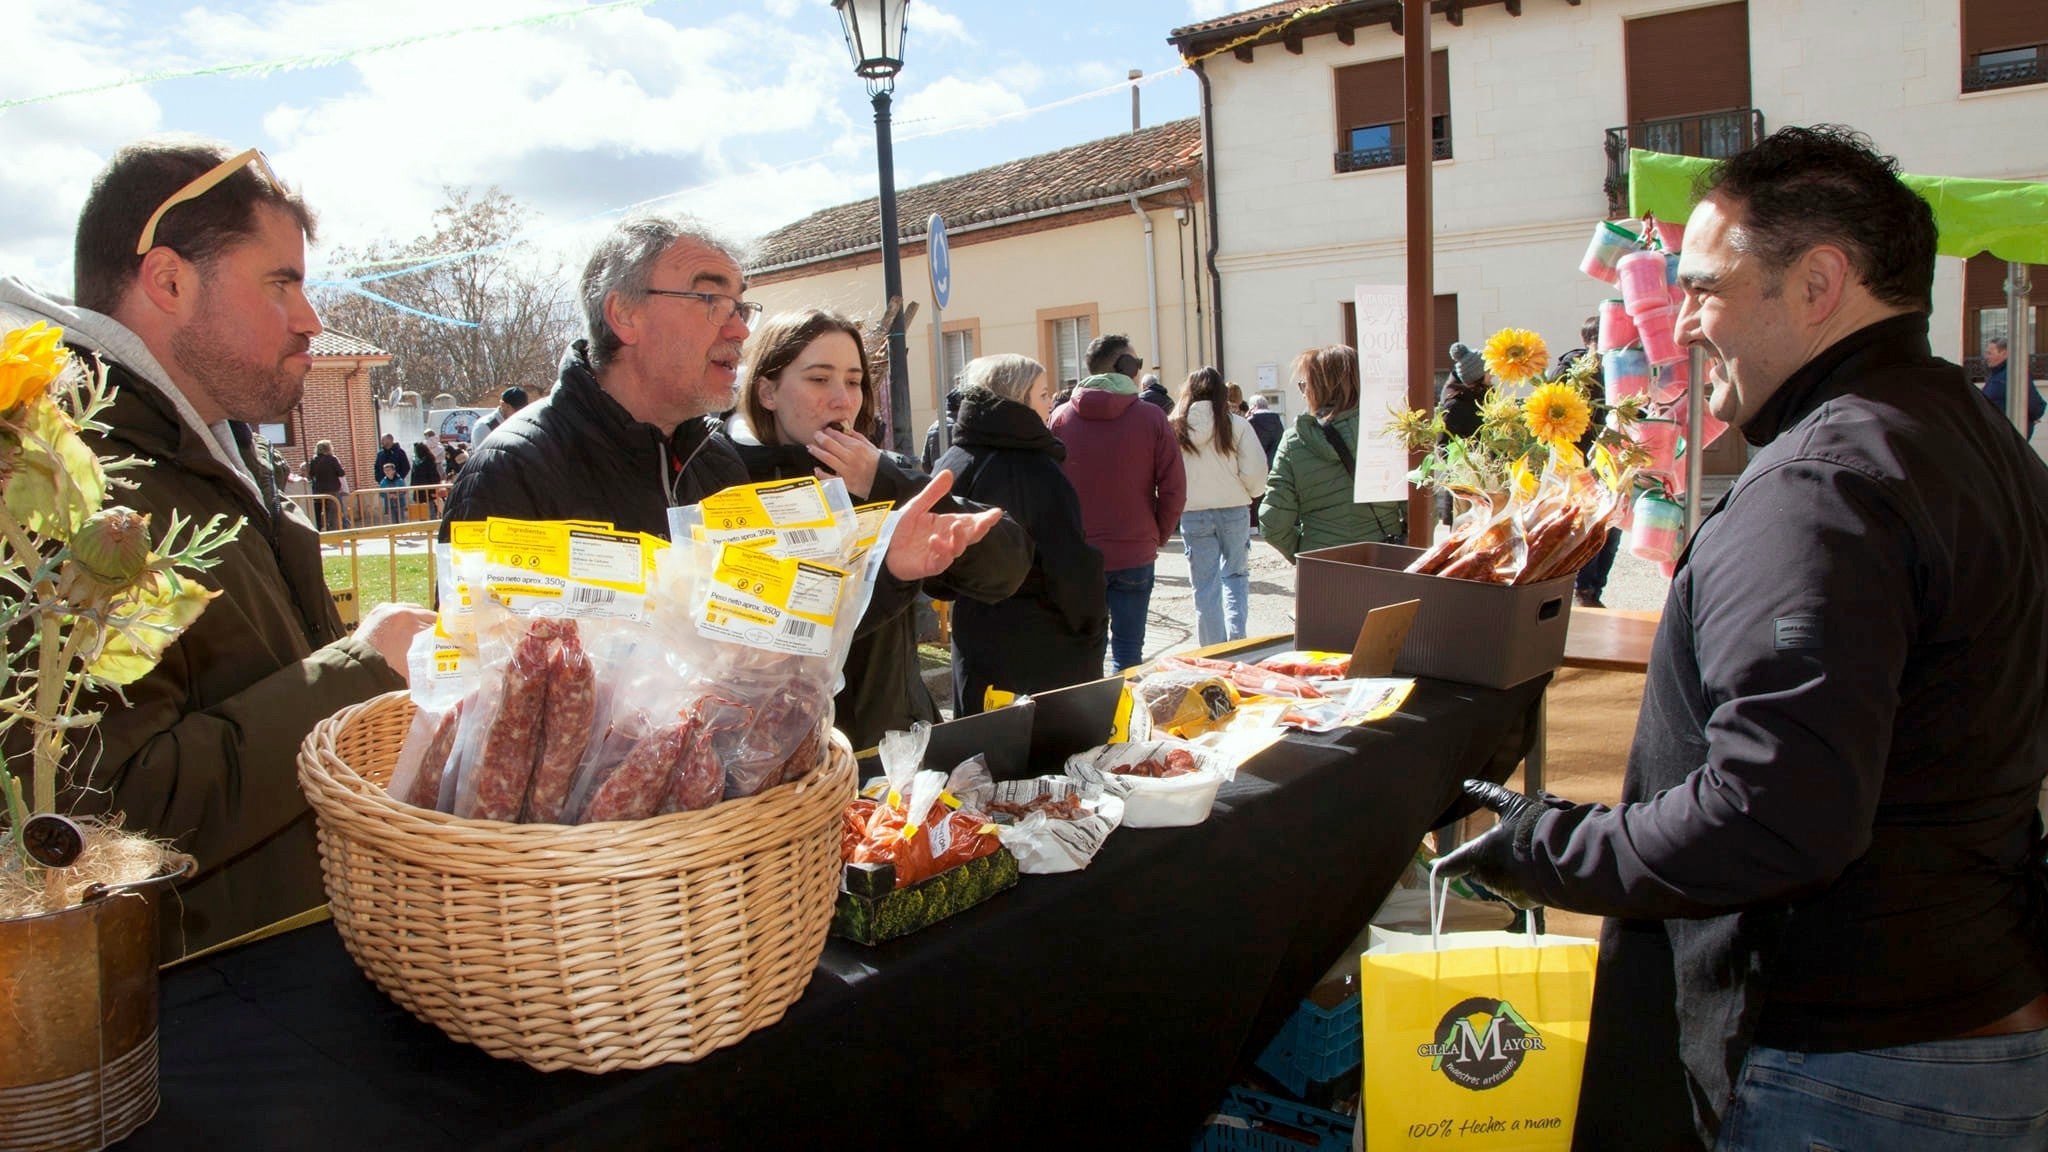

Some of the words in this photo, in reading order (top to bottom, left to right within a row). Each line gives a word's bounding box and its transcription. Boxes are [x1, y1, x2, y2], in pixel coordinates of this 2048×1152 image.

[507, 525, 546, 536] Ingredientes
[487, 574, 504, 582] Peso
[506, 575, 521, 583] neto
[522, 576, 543, 584] aprox.
[545, 577, 566, 588] 350g
[710, 591, 727, 601] Peso
[728, 597, 742, 607] neto
[742, 600, 761, 611] aprox.
[762, 605, 781, 618] 350g
[1417, 1043, 1460, 1057] CILLA
[1446, 1062, 1480, 1086] maestros
[1482, 1058, 1517, 1086] artesanos
[1408, 1119, 1453, 1139] 100%
[1459, 1115, 1507, 1138] Hechos
[1511, 1119, 1520, 1131] a
[1524, 1116, 1563, 1130] mano
